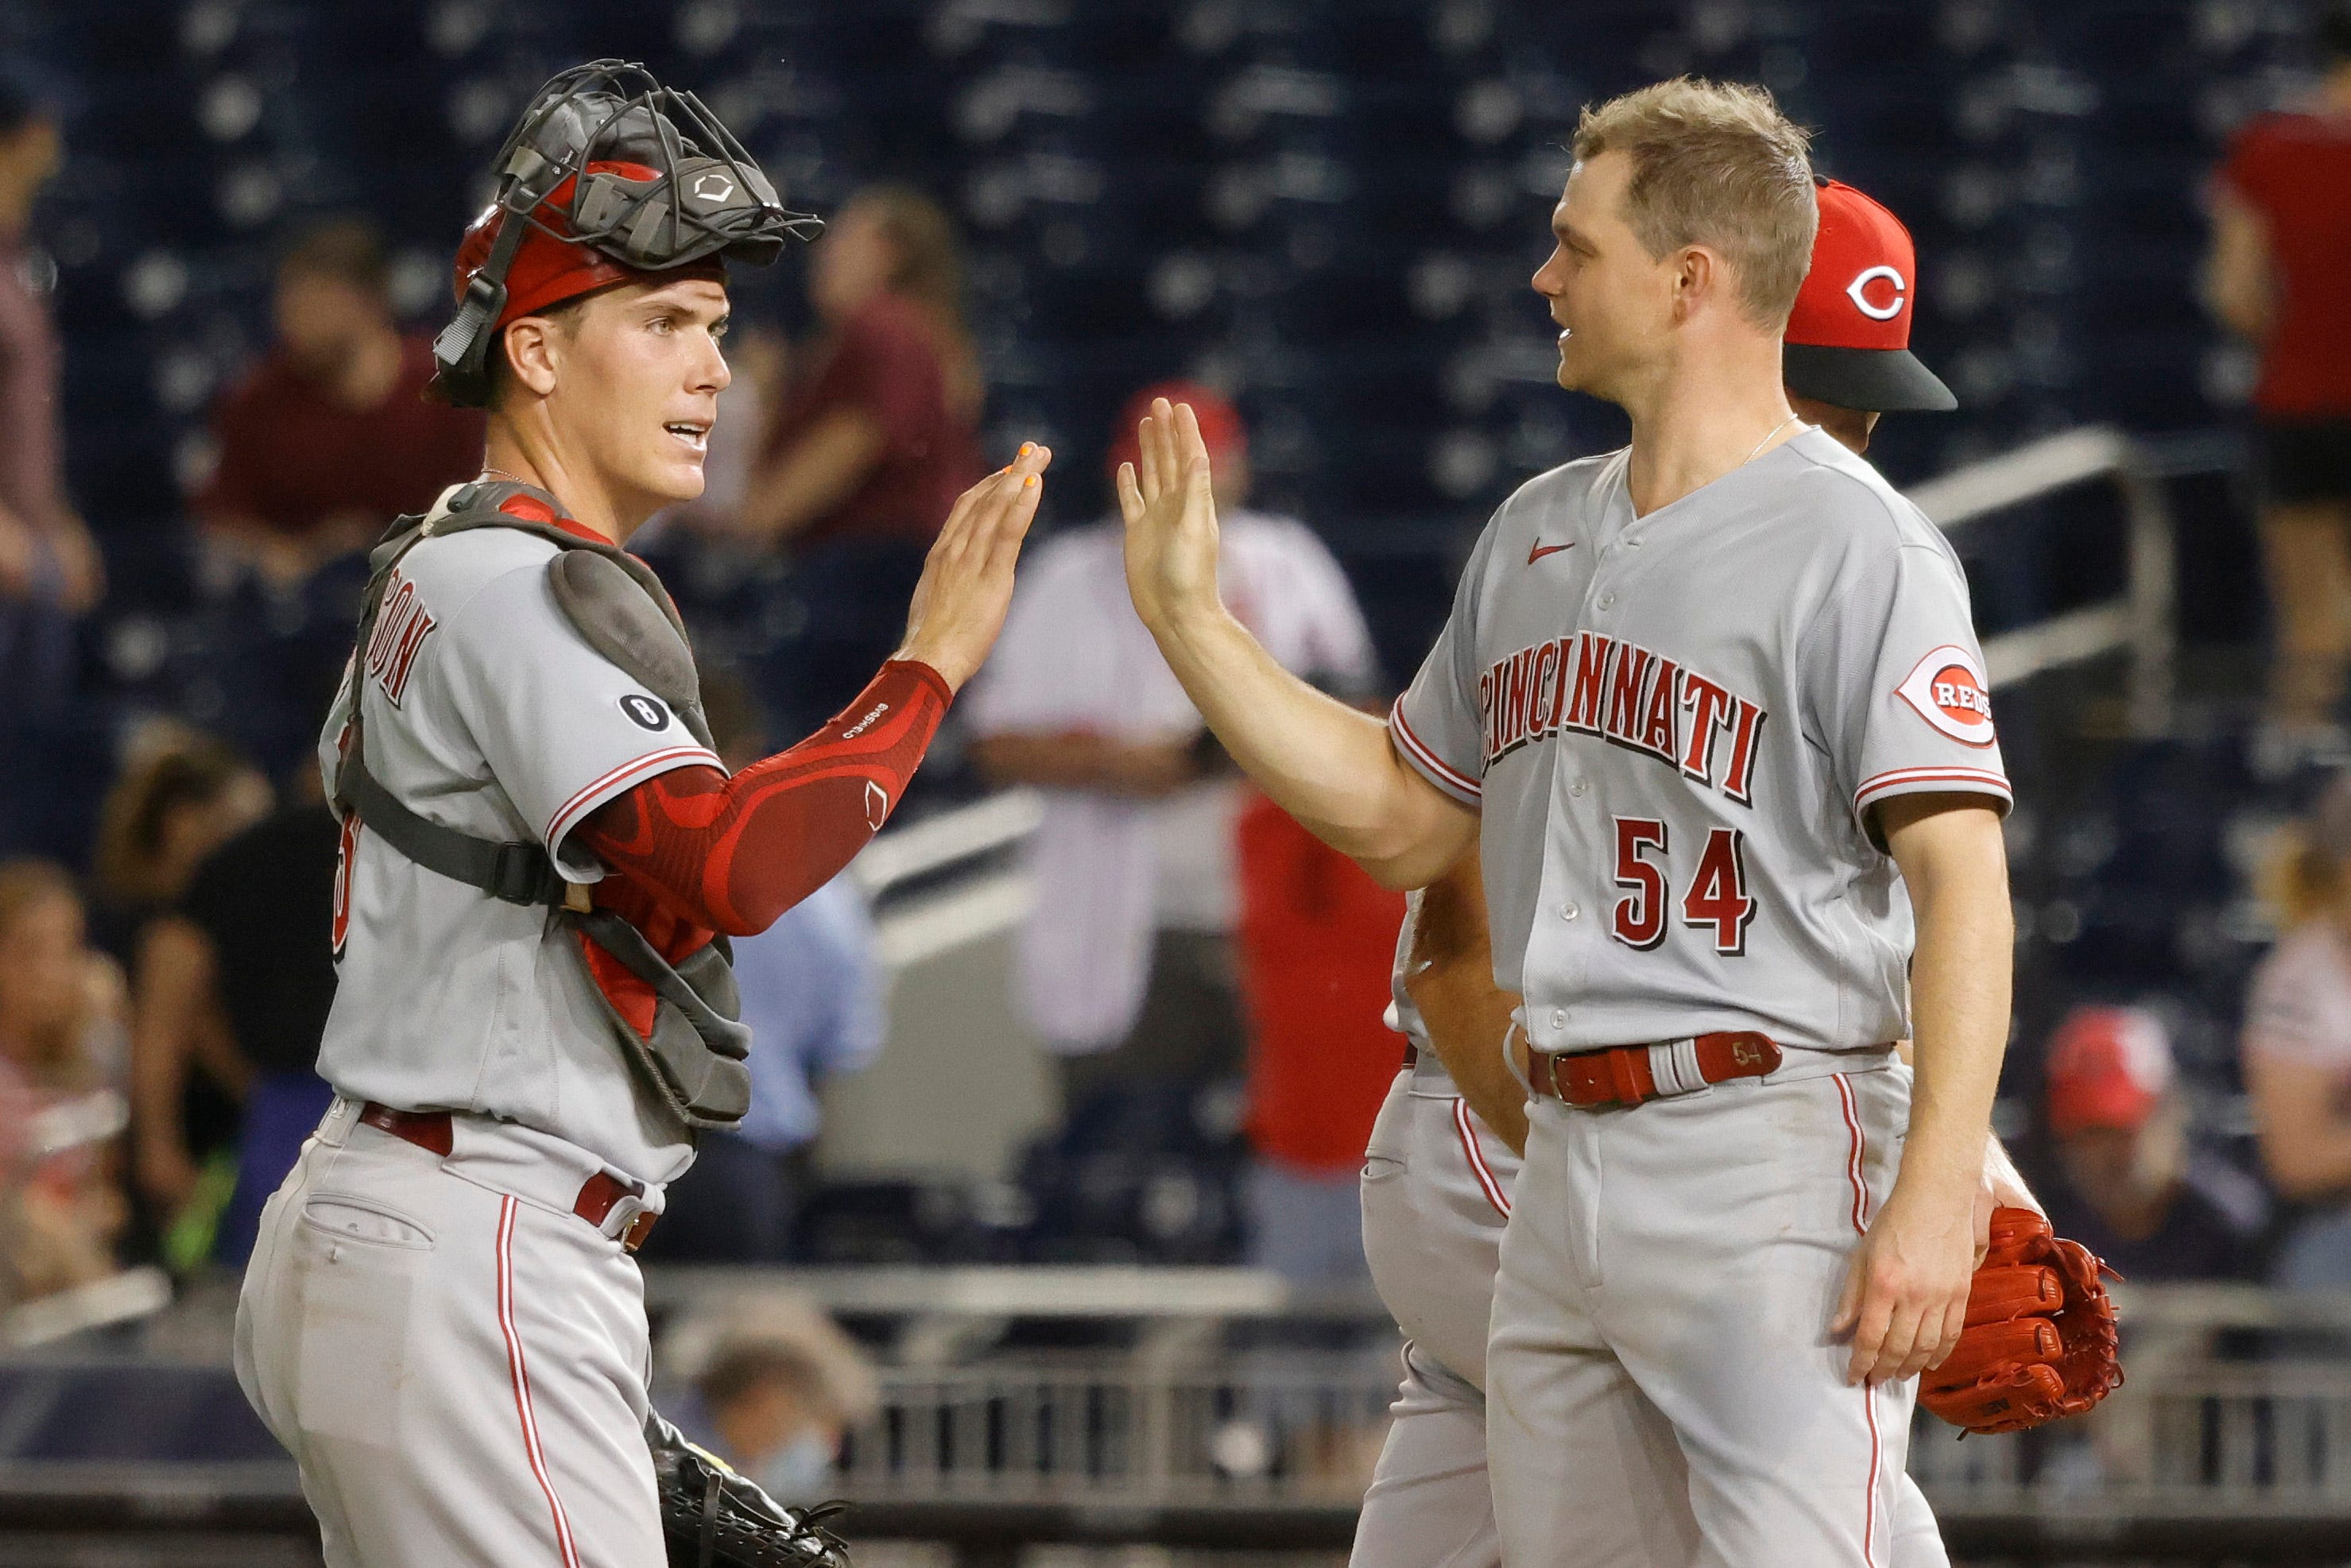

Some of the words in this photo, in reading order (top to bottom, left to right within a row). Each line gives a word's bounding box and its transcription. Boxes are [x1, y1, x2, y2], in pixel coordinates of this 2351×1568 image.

[1846, 265, 1905, 321] C
[630, 698, 660, 725] 8
[1479, 629, 1768, 810] CINCINNATI
[1935, 682, 1992, 721] REDS
[1612, 814, 1757, 957] 54
[1733, 1041, 1763, 1067] 54
